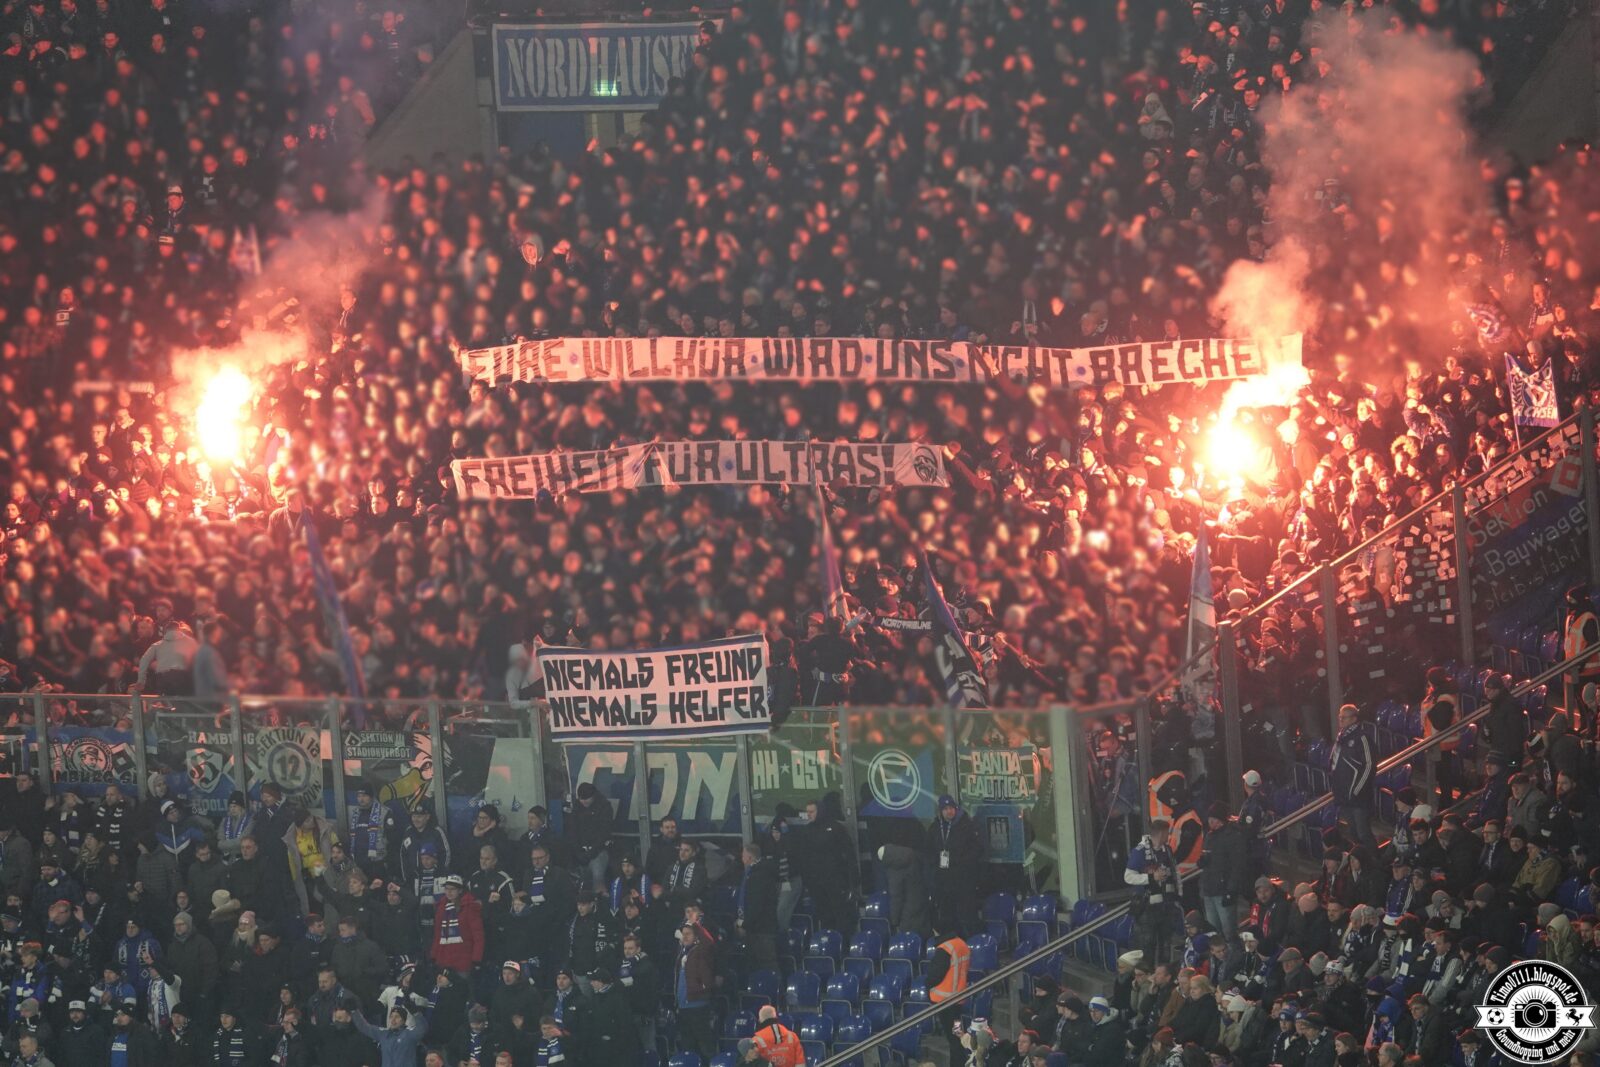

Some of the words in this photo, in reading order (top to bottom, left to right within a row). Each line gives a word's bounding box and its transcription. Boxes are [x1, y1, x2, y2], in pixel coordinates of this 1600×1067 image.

[582, 338, 746, 378] WILLKÜR
[762, 338, 864, 378] WIRD
[876, 340, 955, 379] UNS
[460, 447, 629, 497] FREIHEIT
[642, 442, 721, 483] FÜR
[734, 443, 896, 485] ULTRAS!
[543, 657, 654, 691] NIEMALS
[665, 648, 762, 686] FREUND
[549, 693, 657, 728] NIEMALS
[669, 686, 767, 725] HELFER
[277, 755, 301, 781] 12
